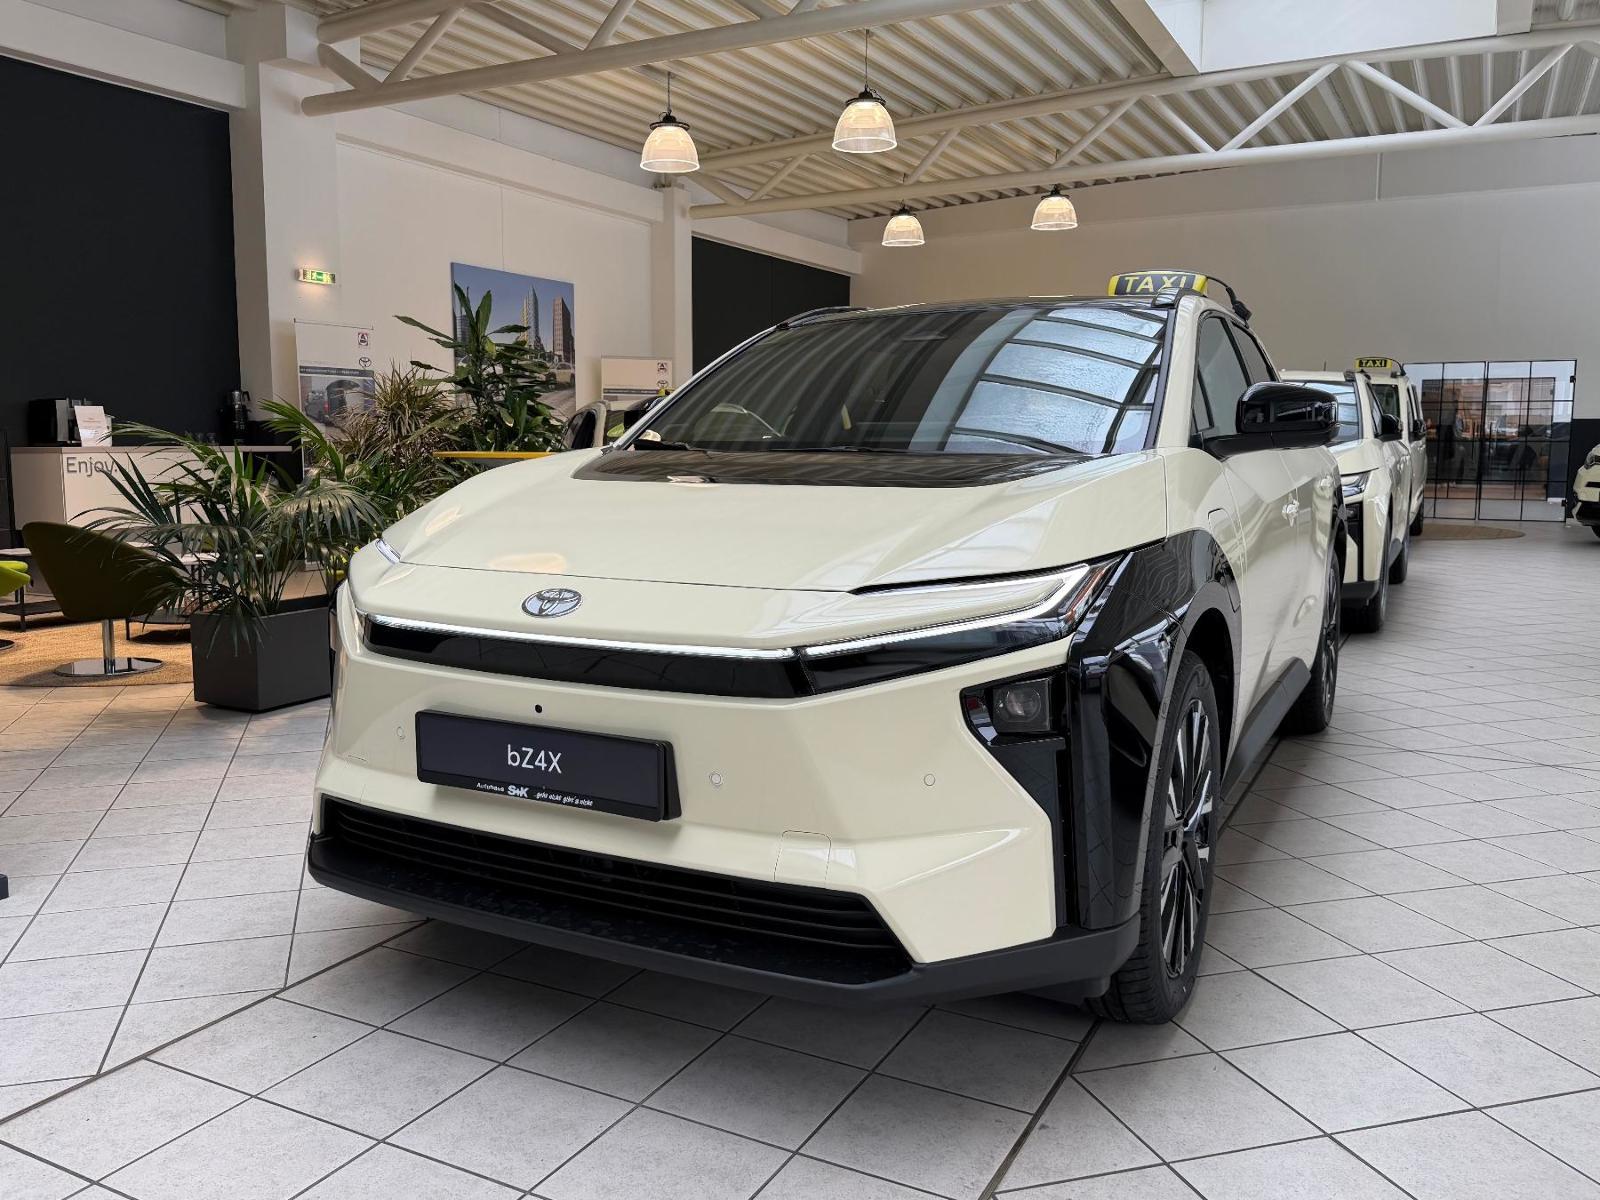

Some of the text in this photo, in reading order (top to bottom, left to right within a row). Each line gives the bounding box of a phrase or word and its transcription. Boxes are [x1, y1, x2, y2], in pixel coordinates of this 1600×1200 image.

[1124, 275, 1187, 293] TAXI
[1361, 359, 1385, 368] TAXI
[507, 743, 562, 774] bZ4X
